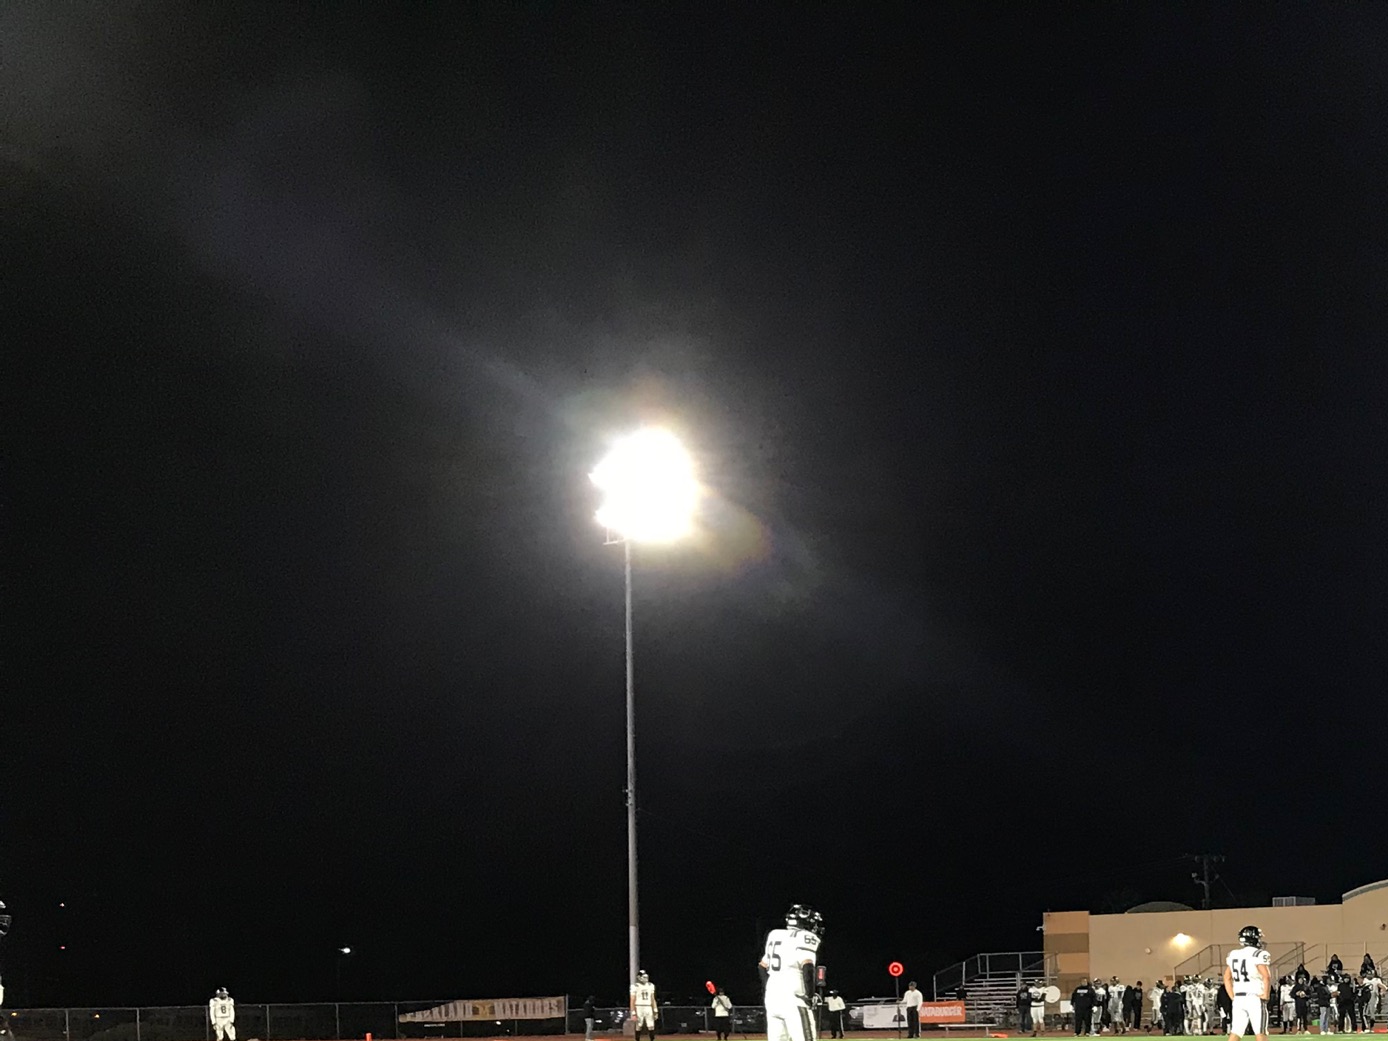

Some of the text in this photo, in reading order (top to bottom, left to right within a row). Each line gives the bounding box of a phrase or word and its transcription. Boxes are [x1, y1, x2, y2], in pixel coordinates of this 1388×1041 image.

[1232, 959, 1250, 982] 54
[220, 1005, 227, 1014] 8
[494, 1000, 559, 1018] MATADORS
